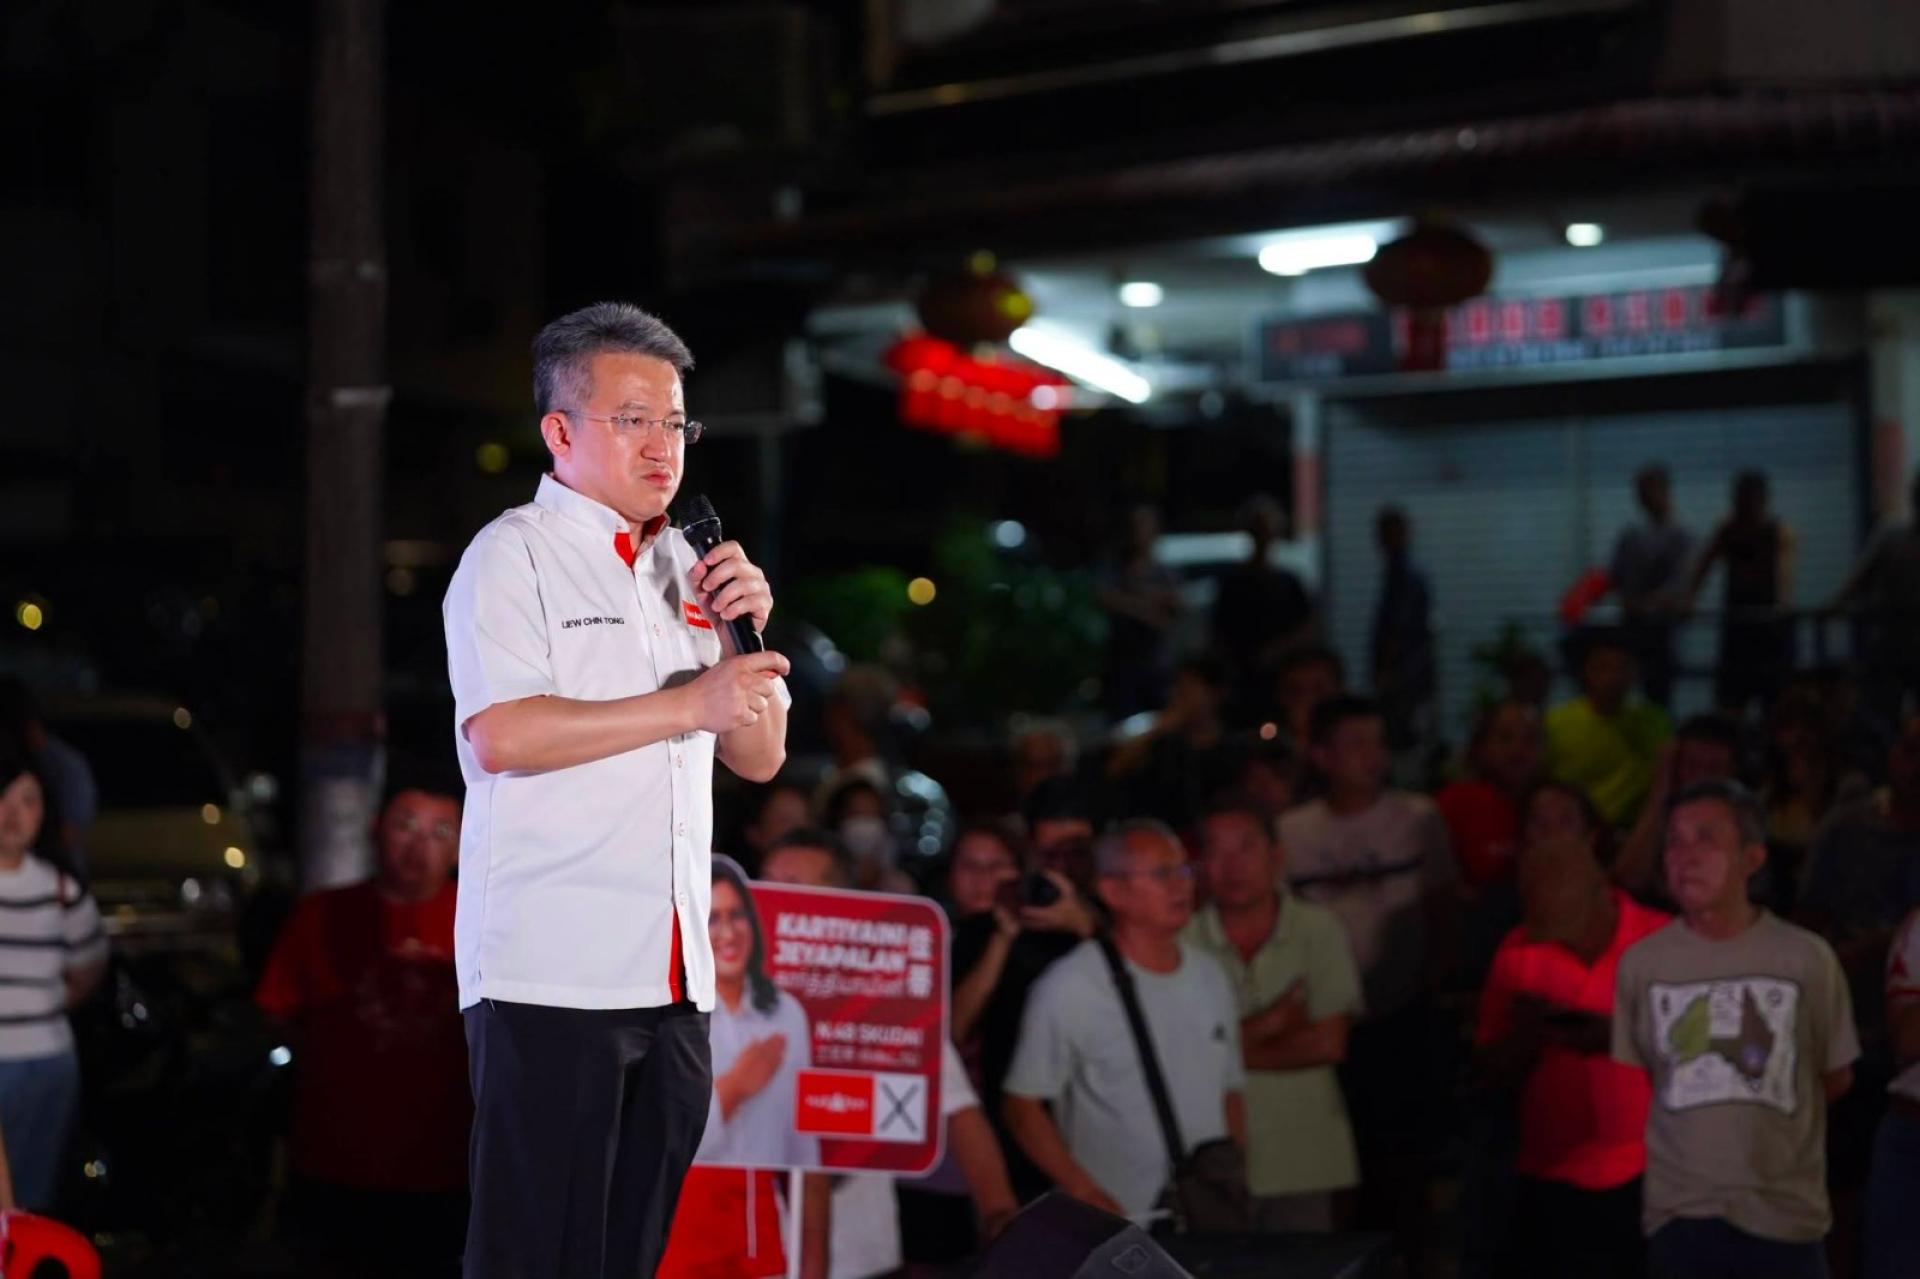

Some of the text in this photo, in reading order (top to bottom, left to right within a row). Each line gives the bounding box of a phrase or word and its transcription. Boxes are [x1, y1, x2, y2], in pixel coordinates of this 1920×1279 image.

[562, 616, 625, 628] LIEW CHIN TONG
[774, 941, 905, 972] JEYAPALAN
